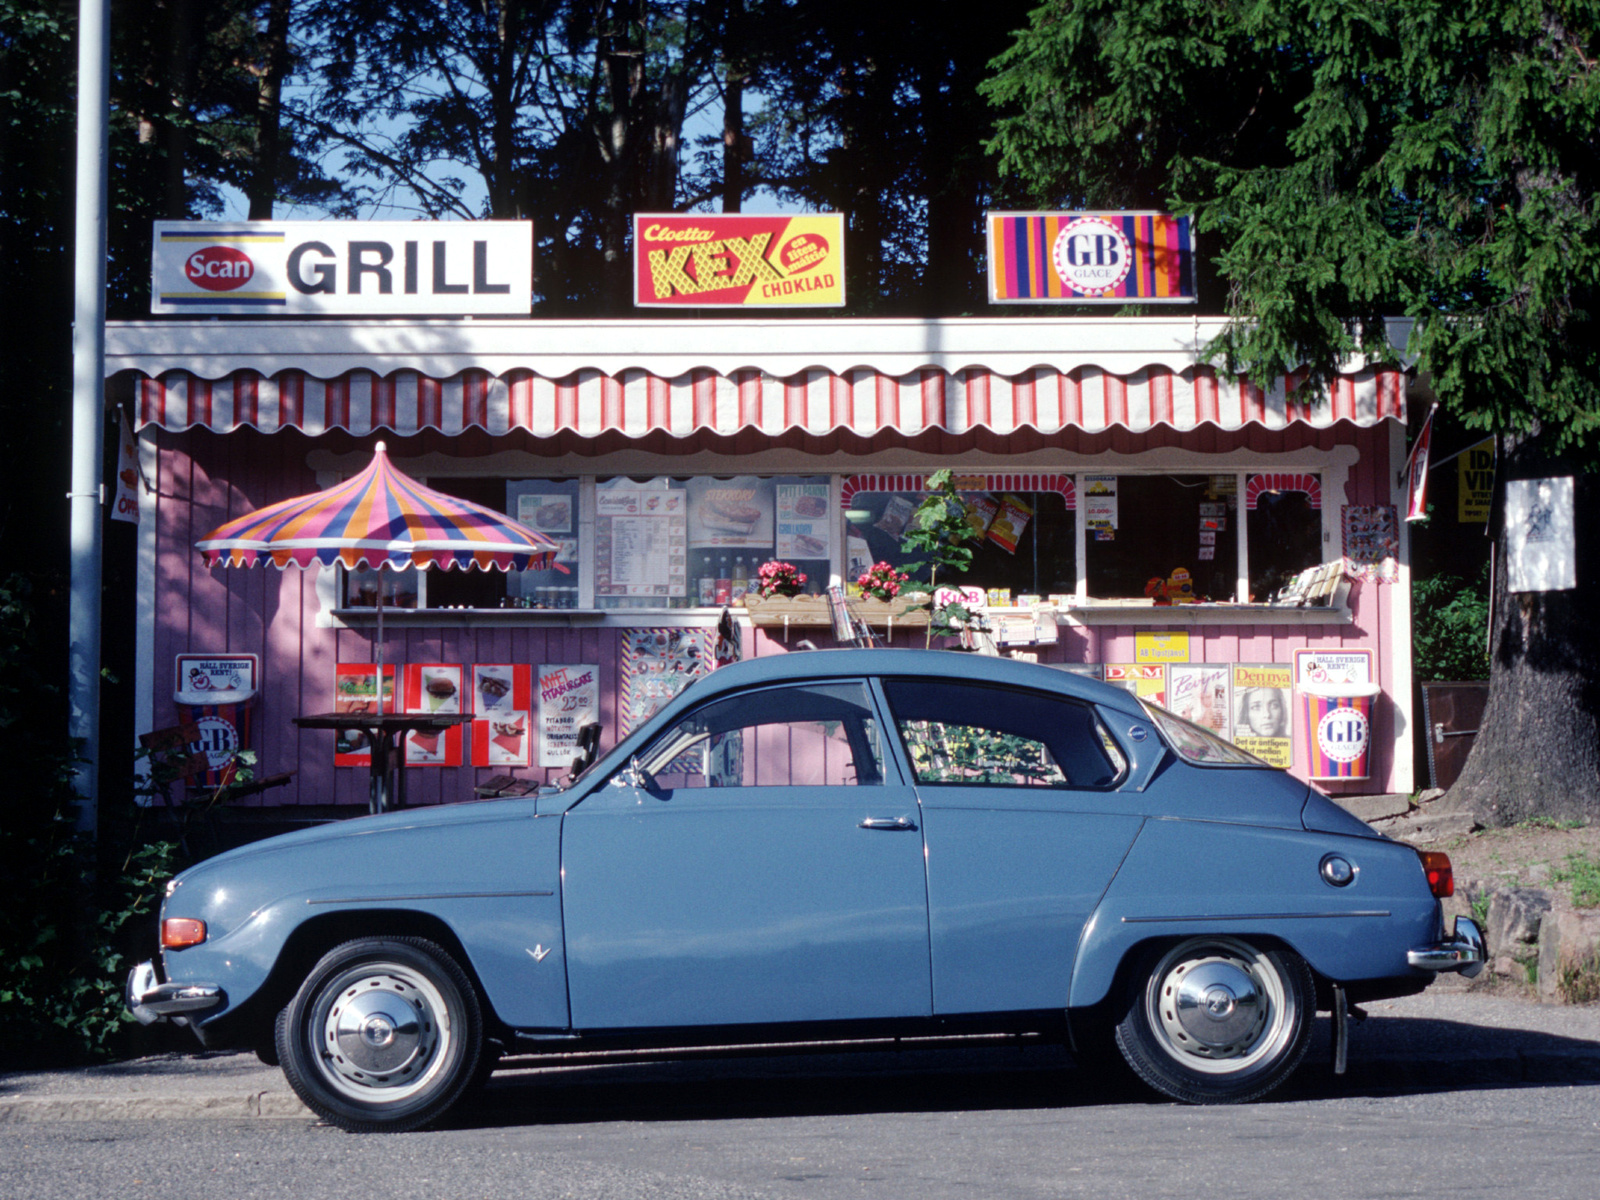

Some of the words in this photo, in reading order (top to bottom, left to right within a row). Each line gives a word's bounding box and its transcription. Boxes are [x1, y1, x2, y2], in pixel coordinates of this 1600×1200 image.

[644, 224, 715, 242] Cloetta
[790, 236, 807, 249] en
[1066, 234, 1119, 266] GB
[787, 242, 817, 262] liten
[189, 255, 251, 279] Scan
[286, 240, 511, 295] GRILL
[648, 232, 784, 299] KEX
[1074, 269, 1112, 278] GLACE
[762, 274, 834, 298] CHOKLAD
[1140, 648, 1149, 657] AB
[1151, 648, 1185, 658] Tipstjänst
[1316, 655, 1334, 664] HÅLL
[1335, 656, 1366, 664] SVERIGE
[200, 662, 218, 670] HÅLL
[219, 662, 250, 670] SVERIGE
[1108, 667, 1163, 678] DAM
[1173, 671, 1228, 696] Revyn
[1236, 668, 1265, 681] Den
[1267, 673, 1290, 687] nya
[1326, 720, 1363, 743] GB
[1235, 737, 1248, 745] Det
[1258, 738, 1289, 748] äntligen
[1257, 747, 1281, 755] mellan
